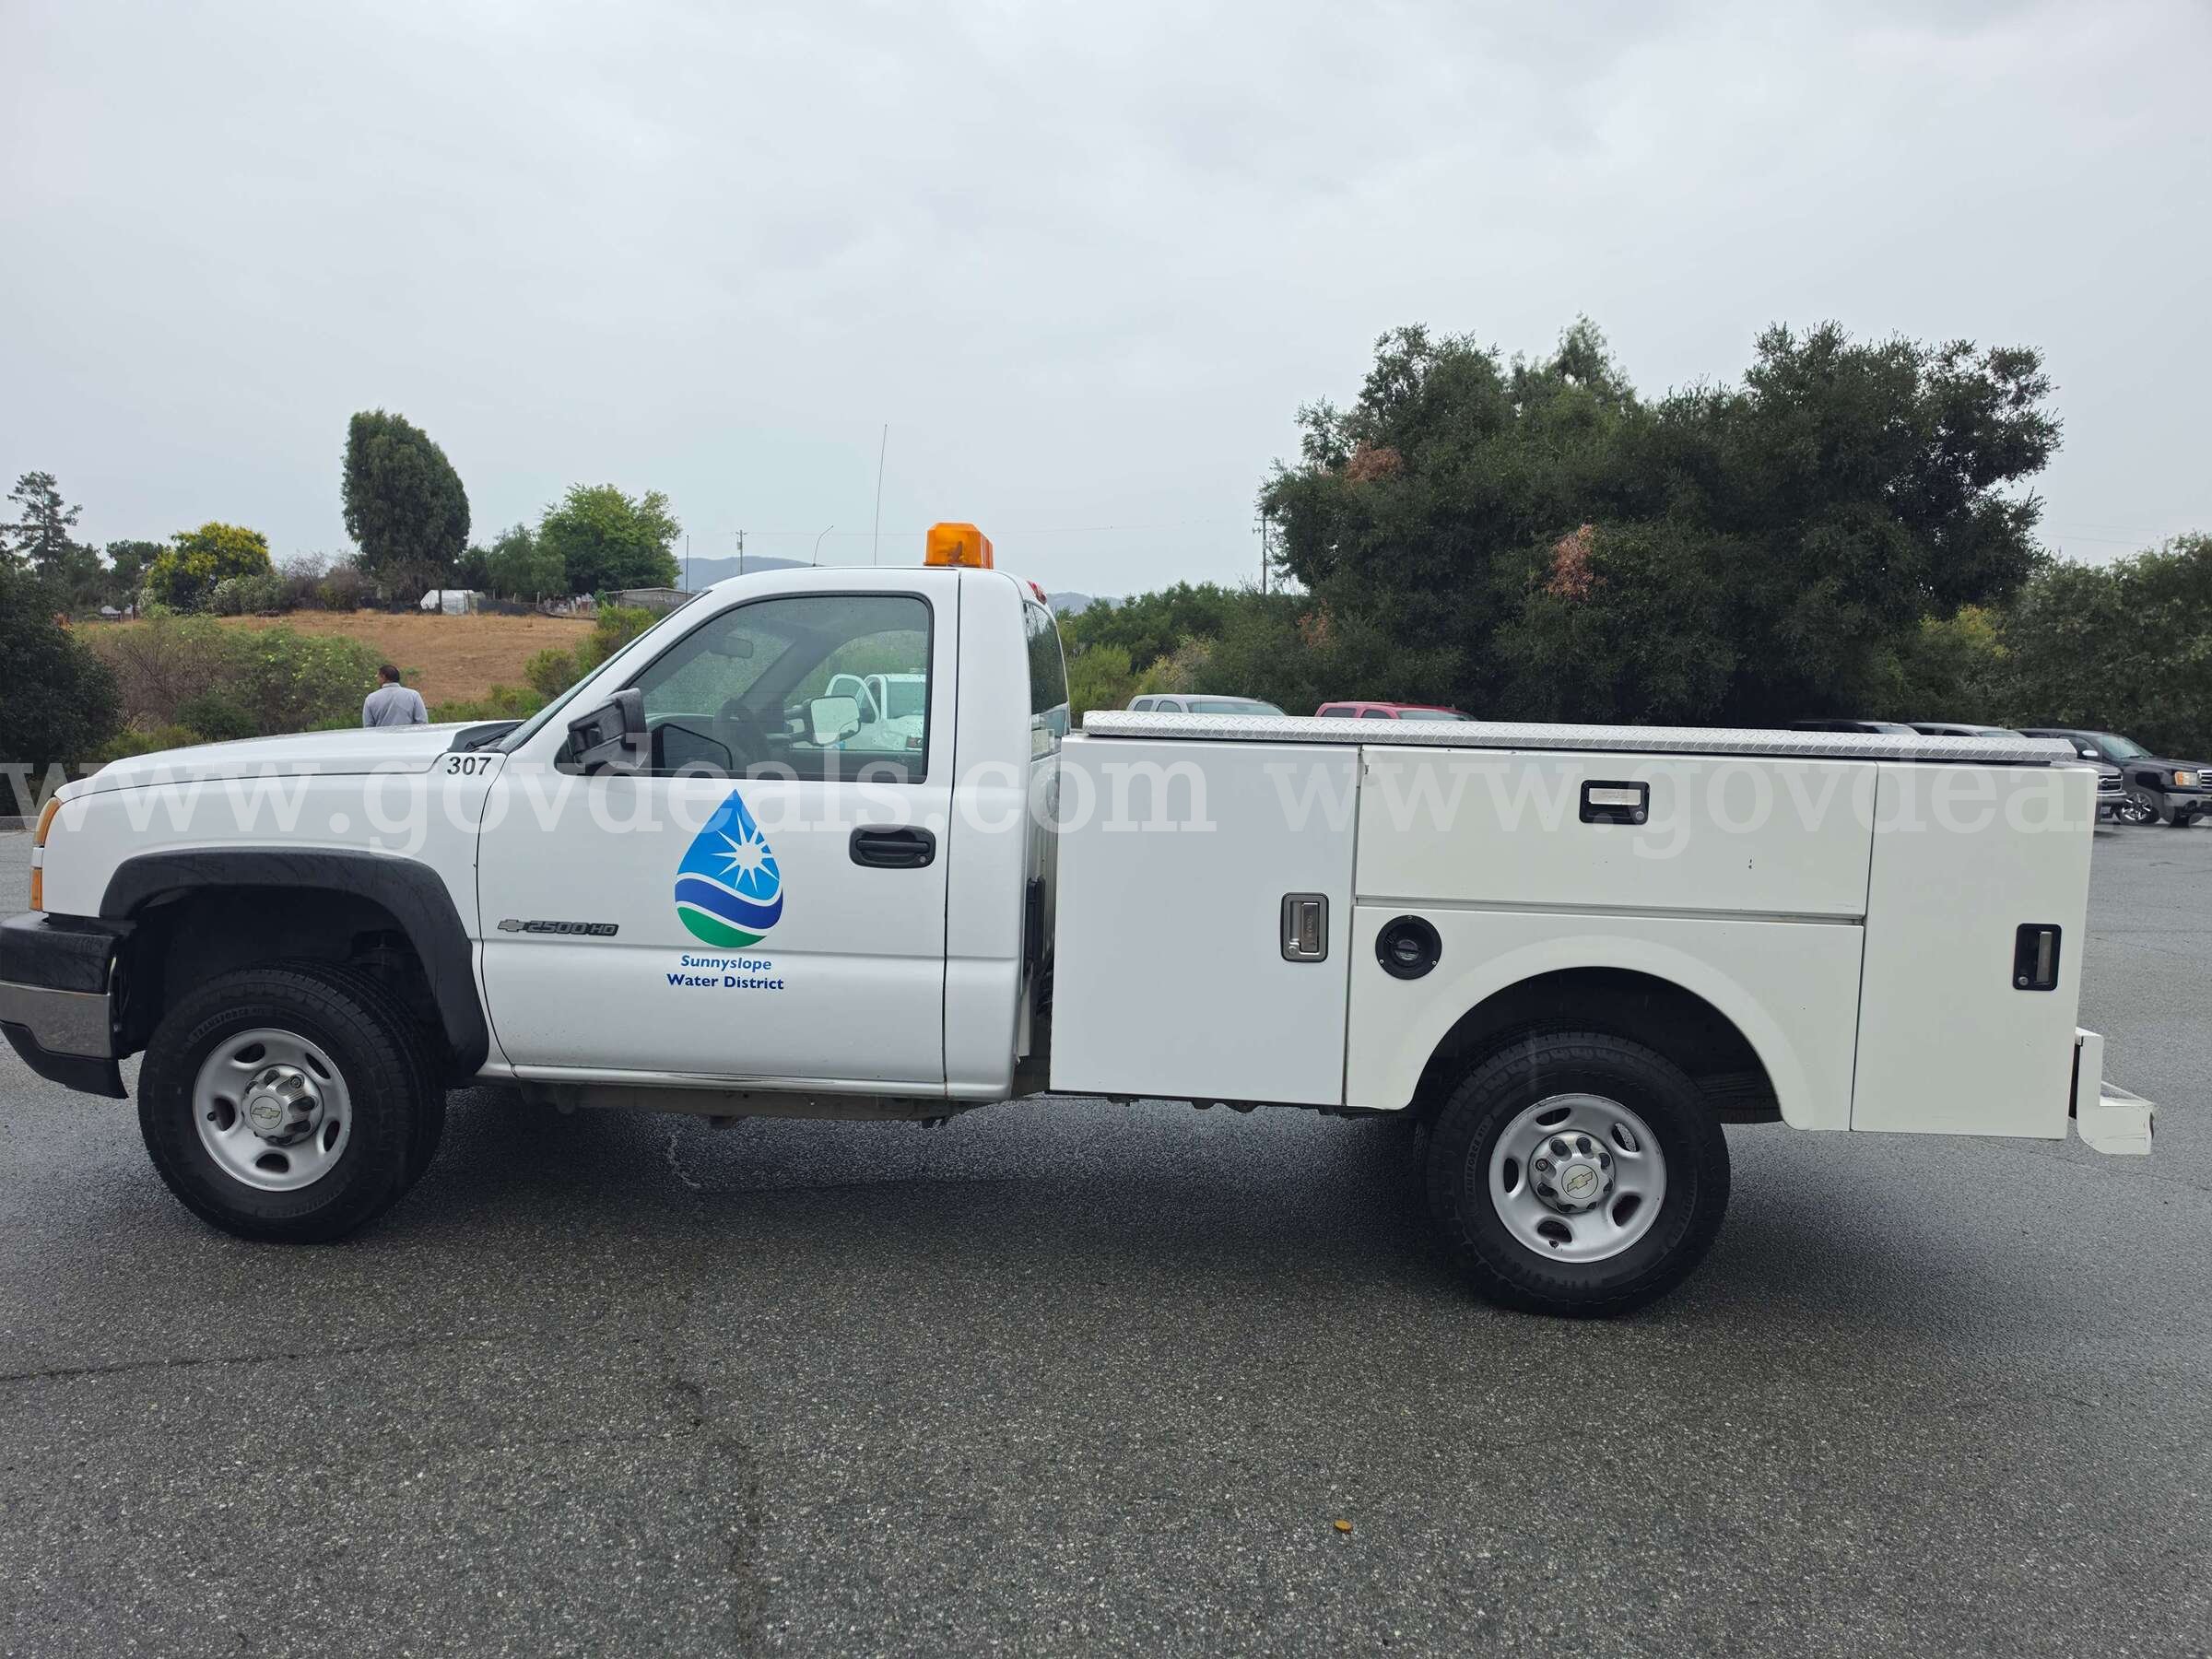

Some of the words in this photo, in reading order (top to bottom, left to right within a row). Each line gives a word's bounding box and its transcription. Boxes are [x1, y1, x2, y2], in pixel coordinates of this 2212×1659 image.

[447, 756, 491, 775] 307
[527, 920, 587, 935] 2500
[590, 923, 617, 935] HD
[680, 955, 771, 972] Sunnyslope
[666, 973, 718, 987] Water
[724, 975, 784, 989] District
